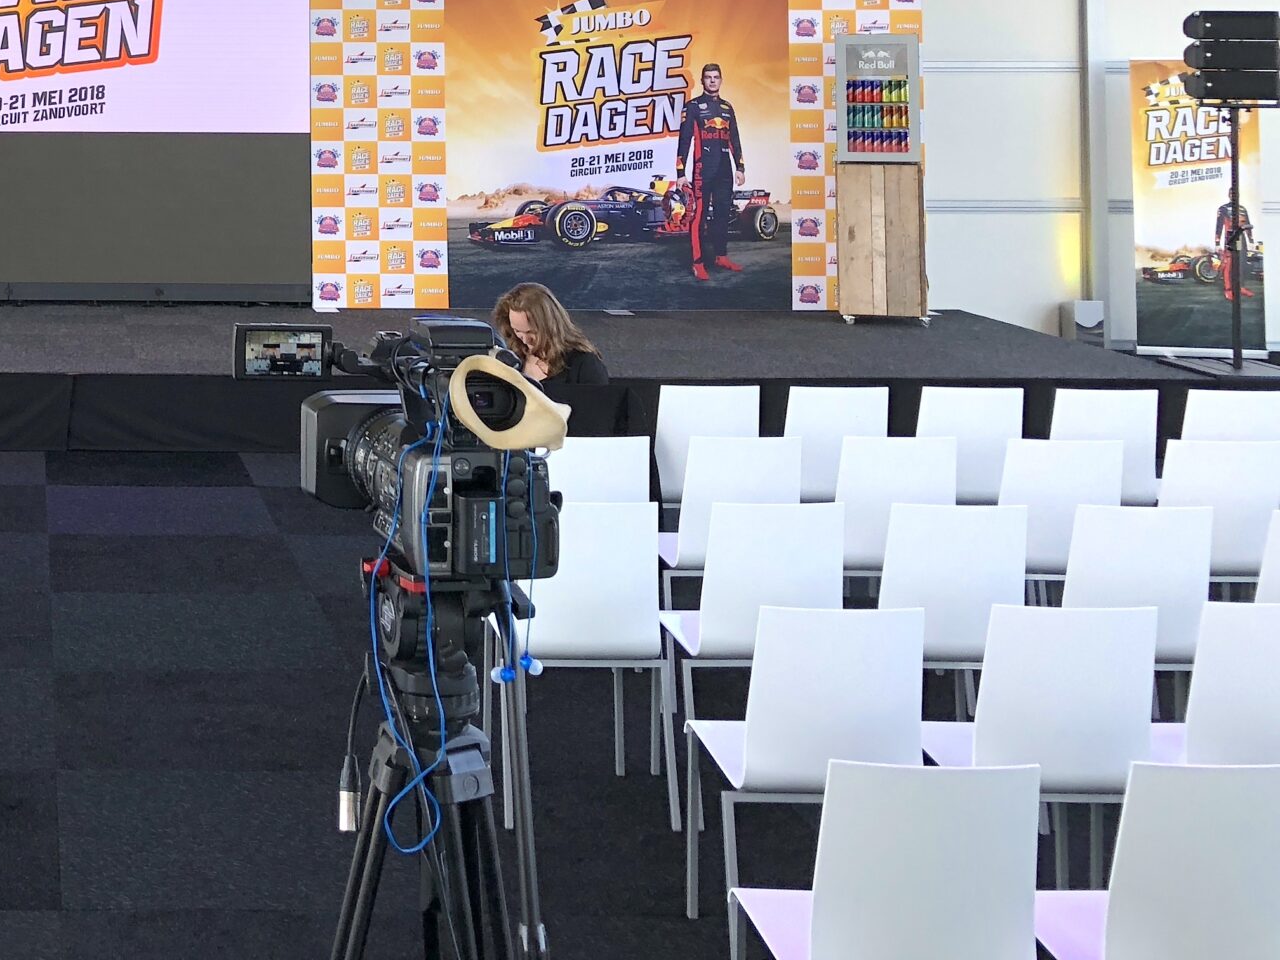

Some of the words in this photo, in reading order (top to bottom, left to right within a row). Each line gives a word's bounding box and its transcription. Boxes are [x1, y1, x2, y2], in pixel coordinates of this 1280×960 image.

[570, 8, 652, 35] JUMBO
[540, 34, 693, 105] RACE
[858, 60, 876, 70] Red
[877, 60, 895, 70] Bull
[31, 89, 64, 108] MEI
[67, 84, 106, 104] 2018
[32, 101, 106, 123] ZANDVOORT
[543, 92, 685, 148] DAGEN
[570, 165, 602, 178] CIRCUIT
[604, 160, 654, 174] ZANDVOORT
[571, 156, 601, 168] 20-21
[604, 152, 625, 165] MEI
[628, 149, 654, 161] 2018
[494, 230, 523, 241] Mobil
